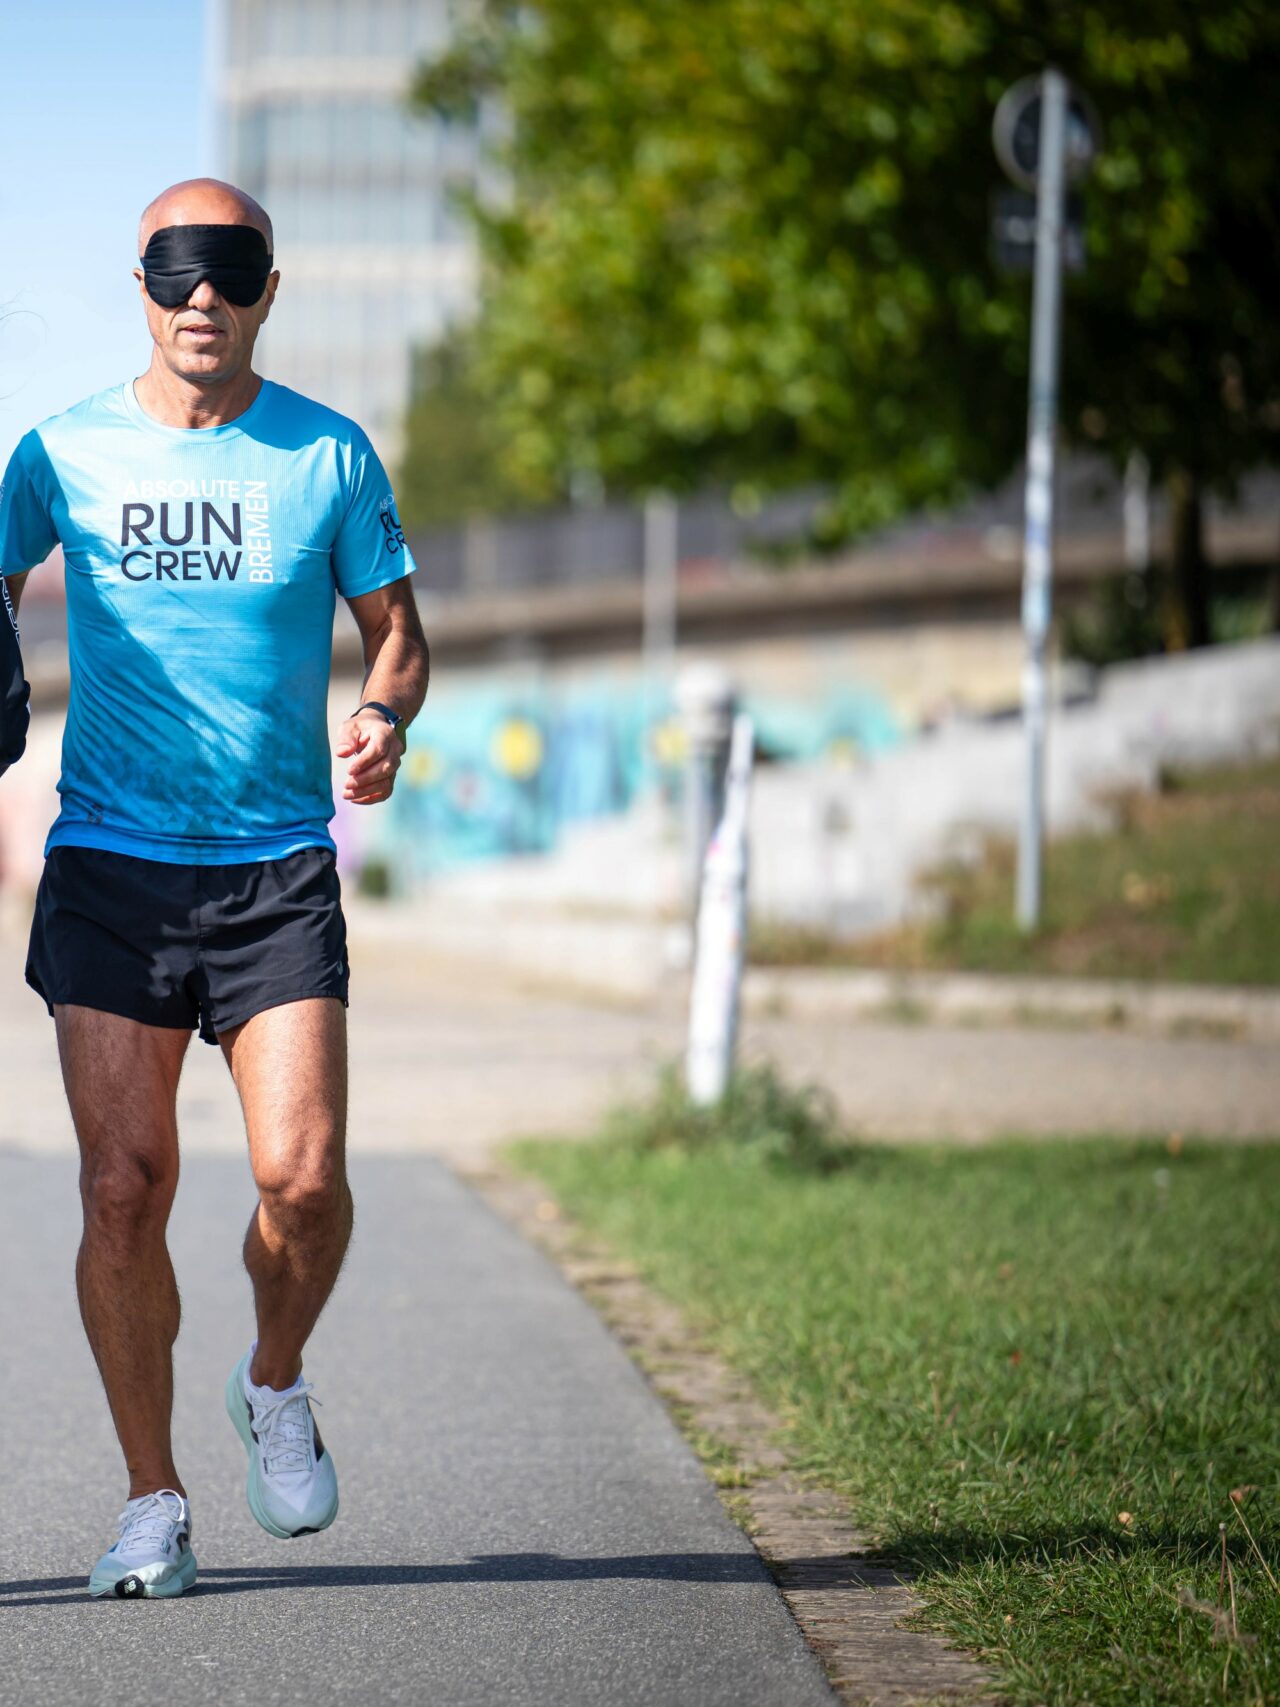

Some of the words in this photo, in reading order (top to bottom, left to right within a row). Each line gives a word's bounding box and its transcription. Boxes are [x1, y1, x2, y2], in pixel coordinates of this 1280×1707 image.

[124, 479, 241, 499] ABSOLUTE
[121, 501, 243, 547] RUN
[244, 480, 274, 584] BREMEN
[121, 550, 243, 582] CREW
